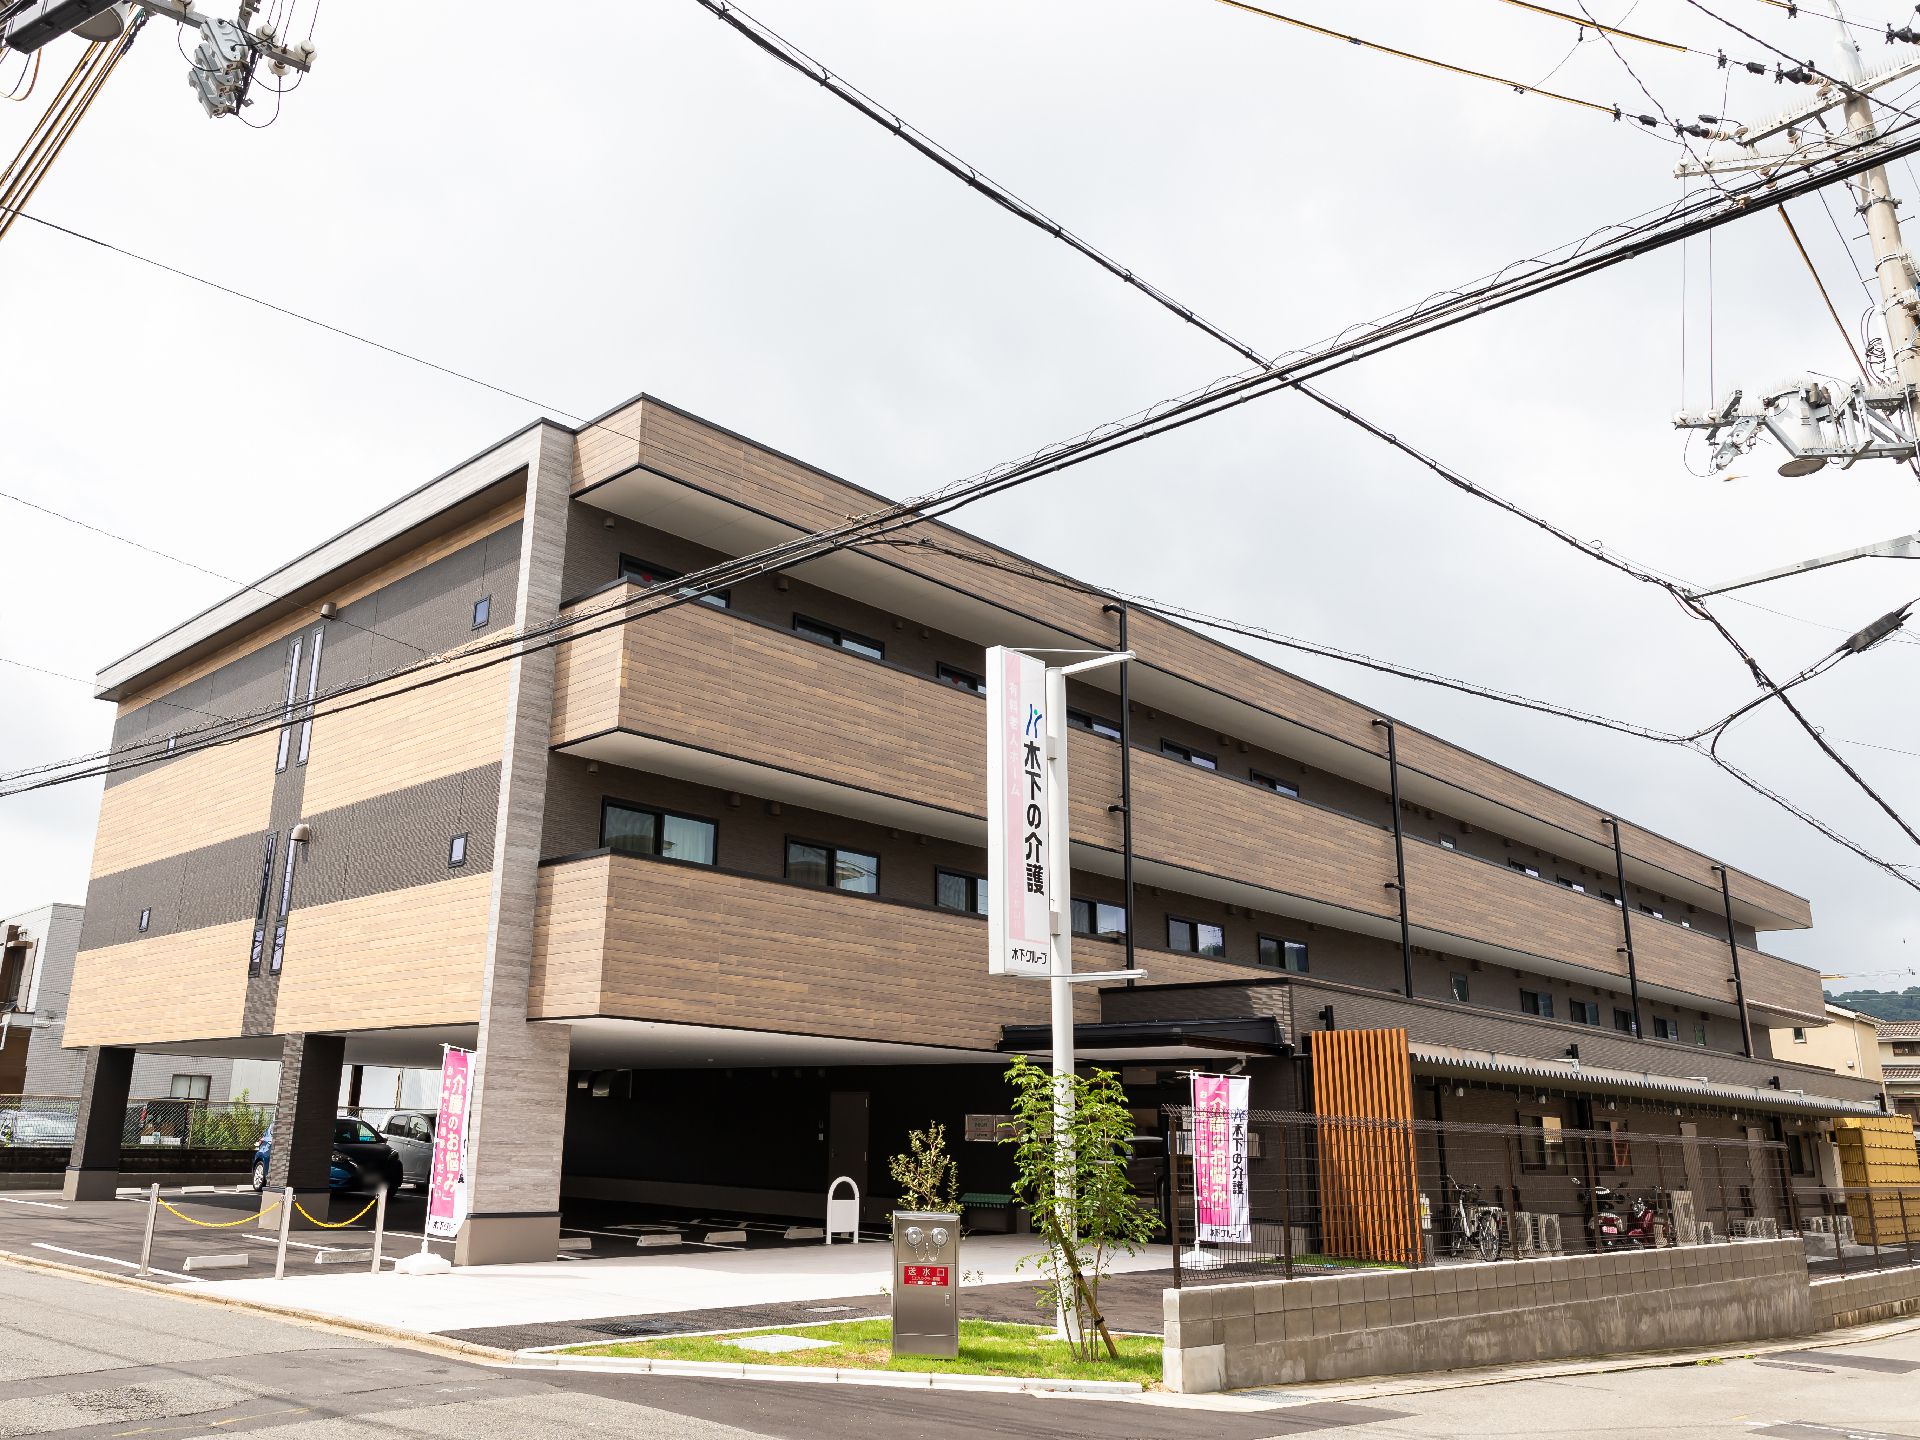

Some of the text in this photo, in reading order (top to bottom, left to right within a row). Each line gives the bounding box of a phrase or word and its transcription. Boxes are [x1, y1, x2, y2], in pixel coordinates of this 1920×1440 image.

[1023, 740, 1044, 896] 木下の介護
[1011, 947, 1048, 965] 木下グループ
[1232, 1123, 1245, 1195] 木下の介護
[907, 1266, 945, 1277] 送水口
